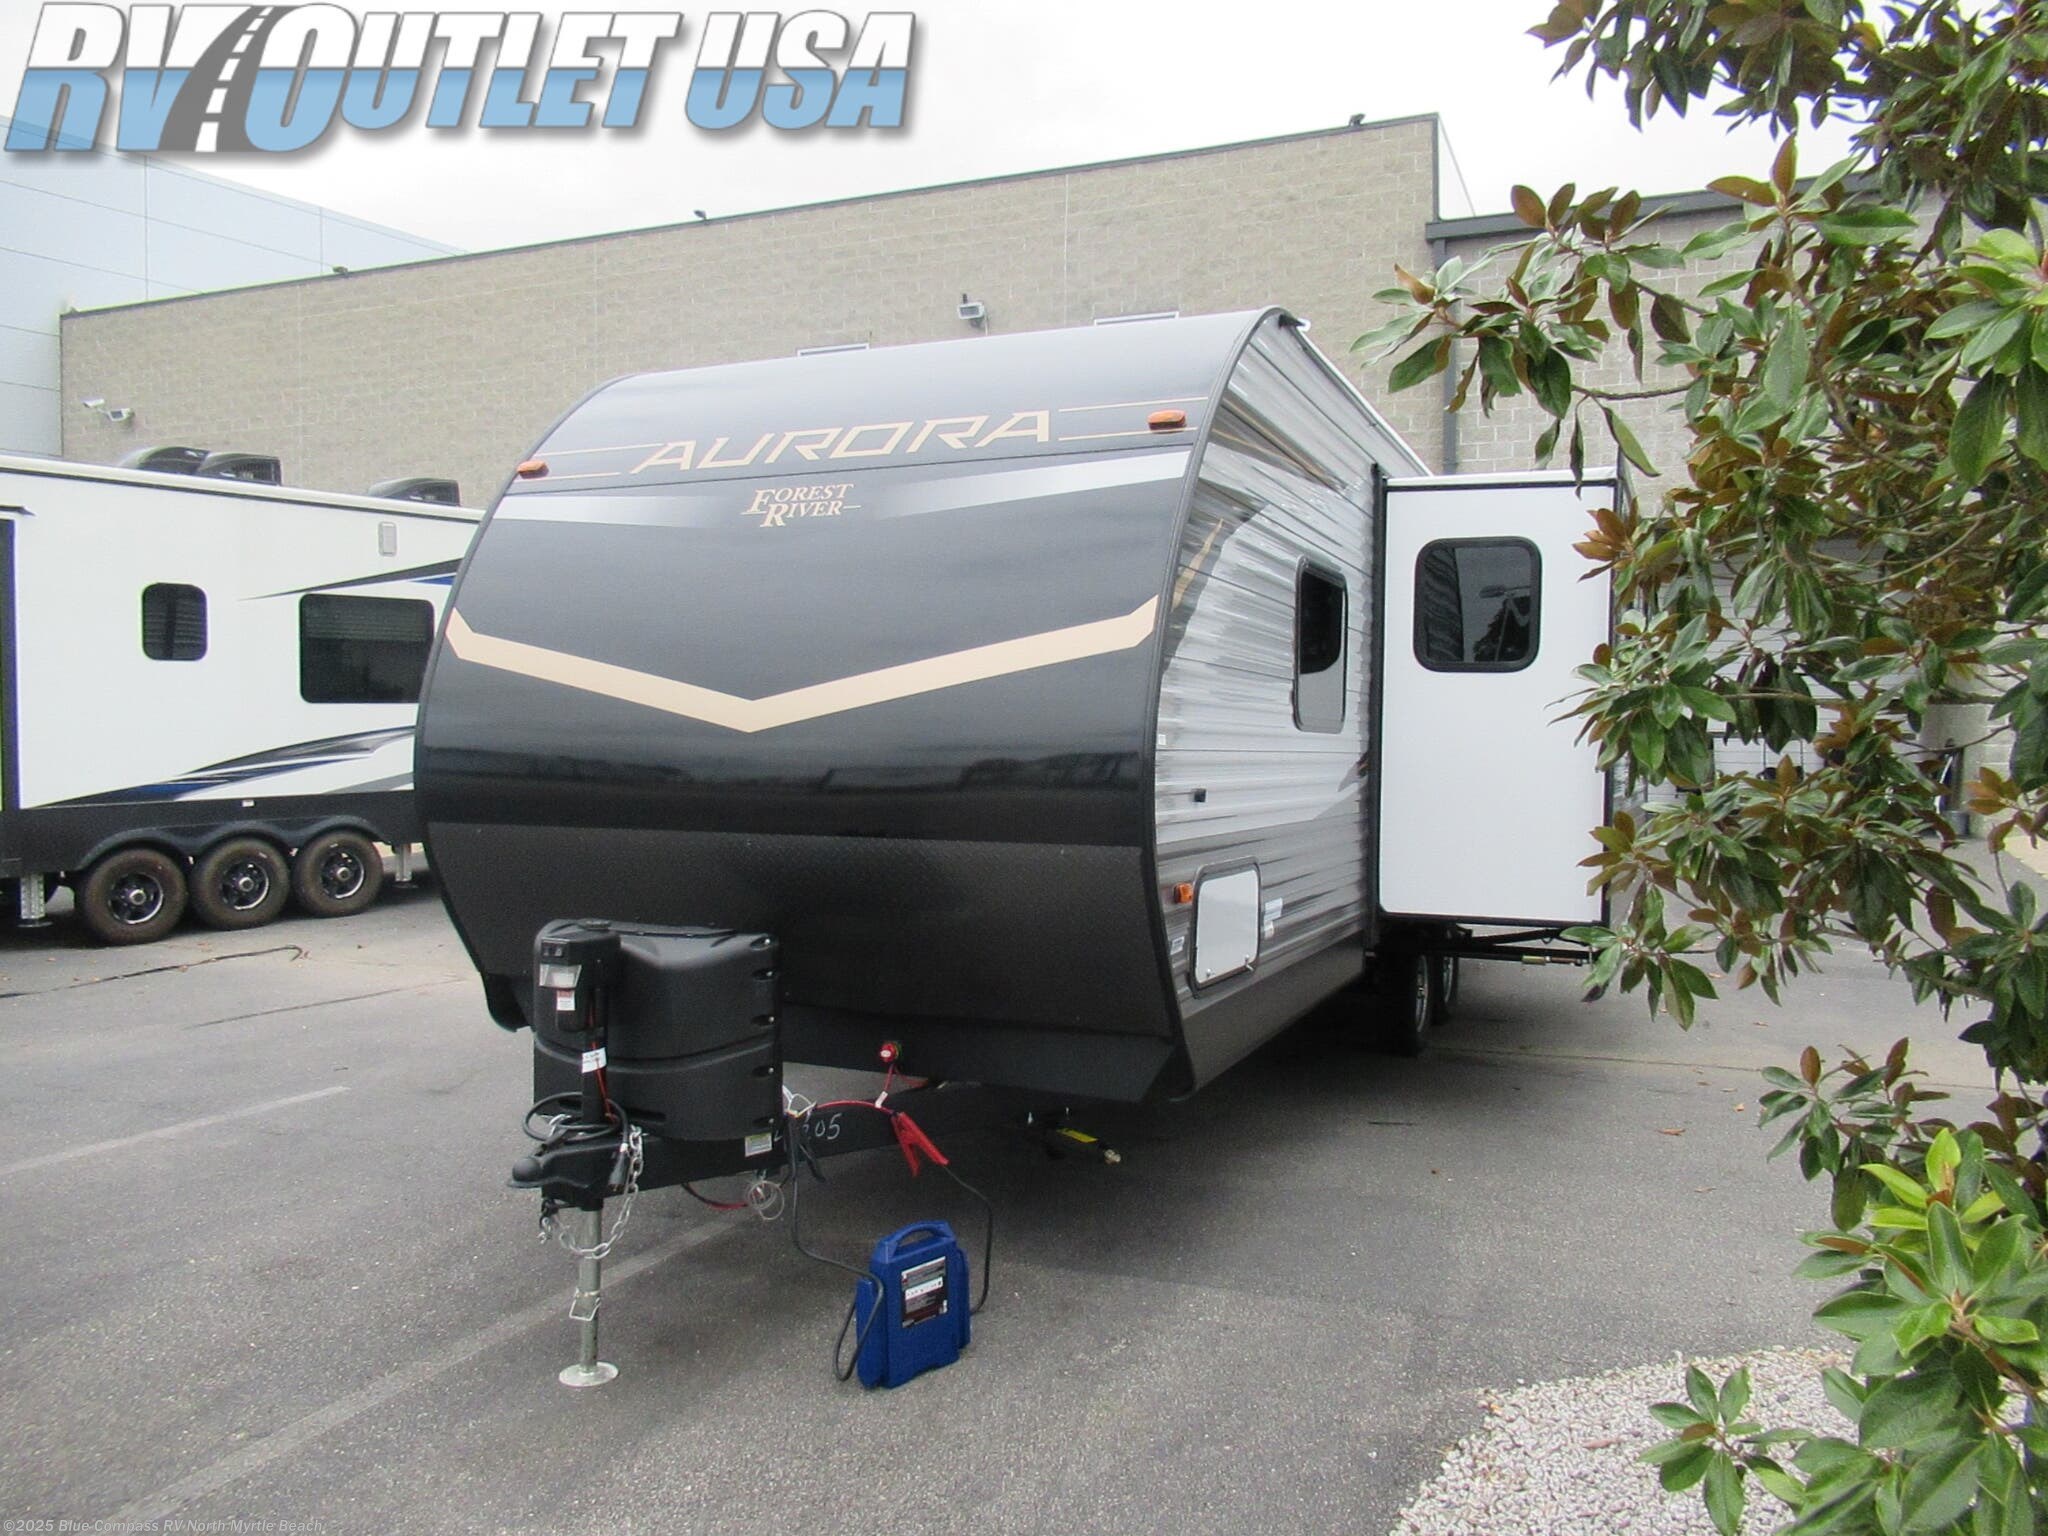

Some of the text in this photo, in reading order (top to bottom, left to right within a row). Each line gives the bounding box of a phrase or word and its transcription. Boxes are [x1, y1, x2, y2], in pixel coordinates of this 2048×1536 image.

[630, 409, 1051, 474] AURORA
[745, 483, 854, 512] FOREST
[759, 500, 843, 528] RIVER
